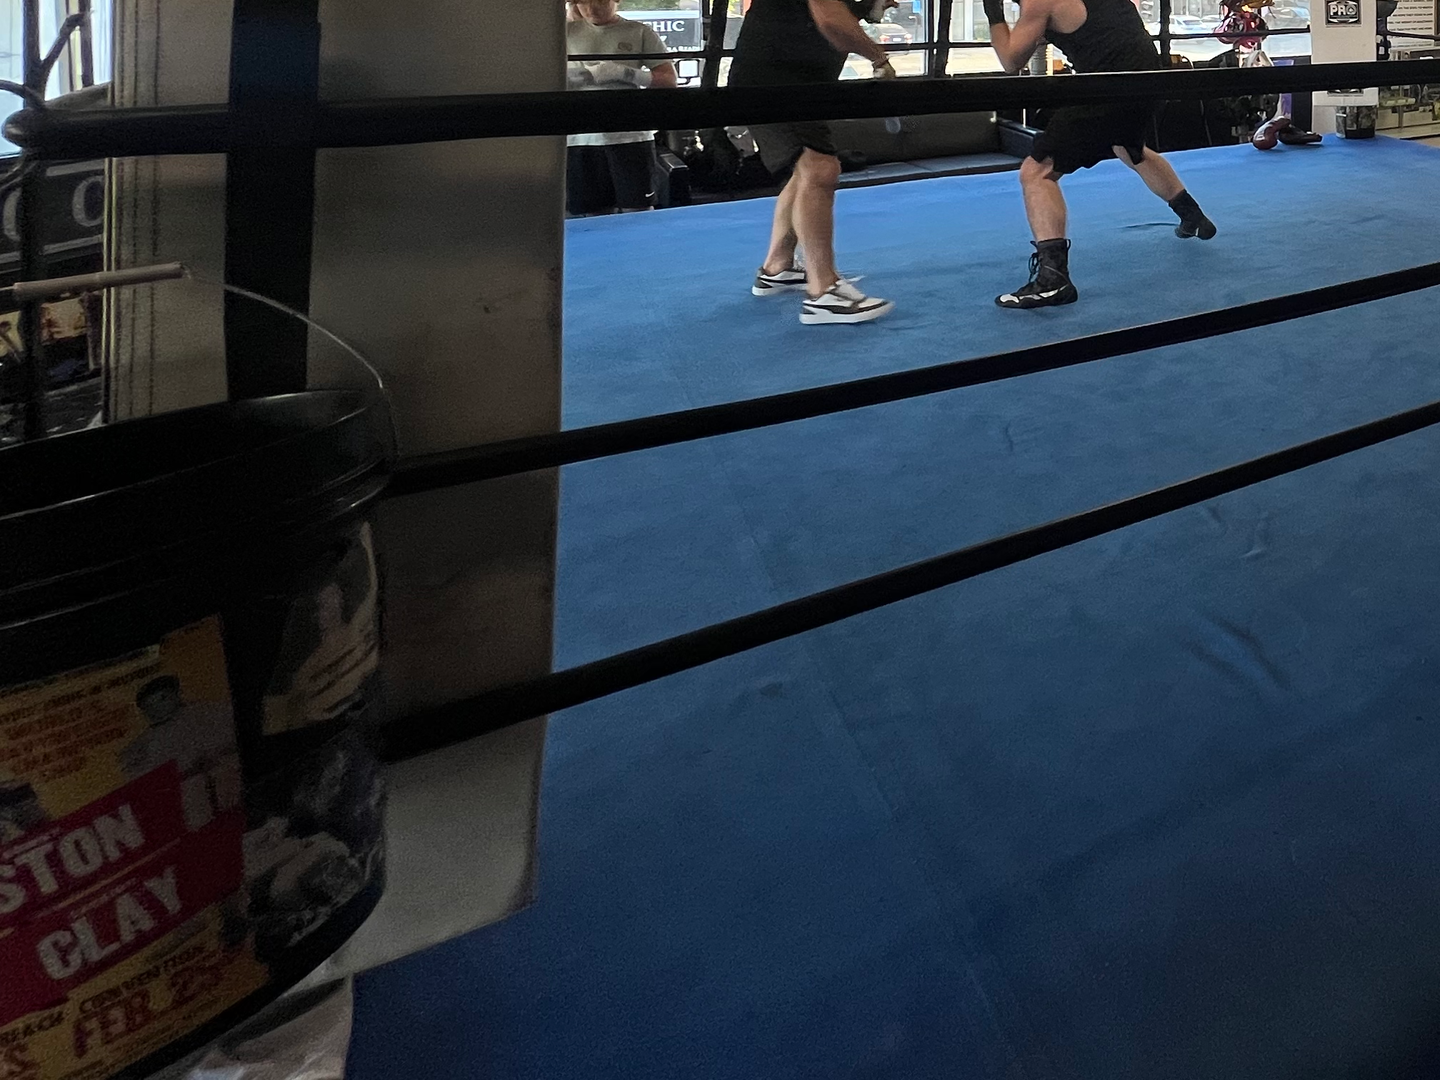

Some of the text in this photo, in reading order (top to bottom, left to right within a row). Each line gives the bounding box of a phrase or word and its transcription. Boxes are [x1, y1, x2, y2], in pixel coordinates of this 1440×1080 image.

[1329, 4, 1357, 16] PRO
[36, 864, 184, 982] CLAY
[72, 985, 152, 1060] FEB
